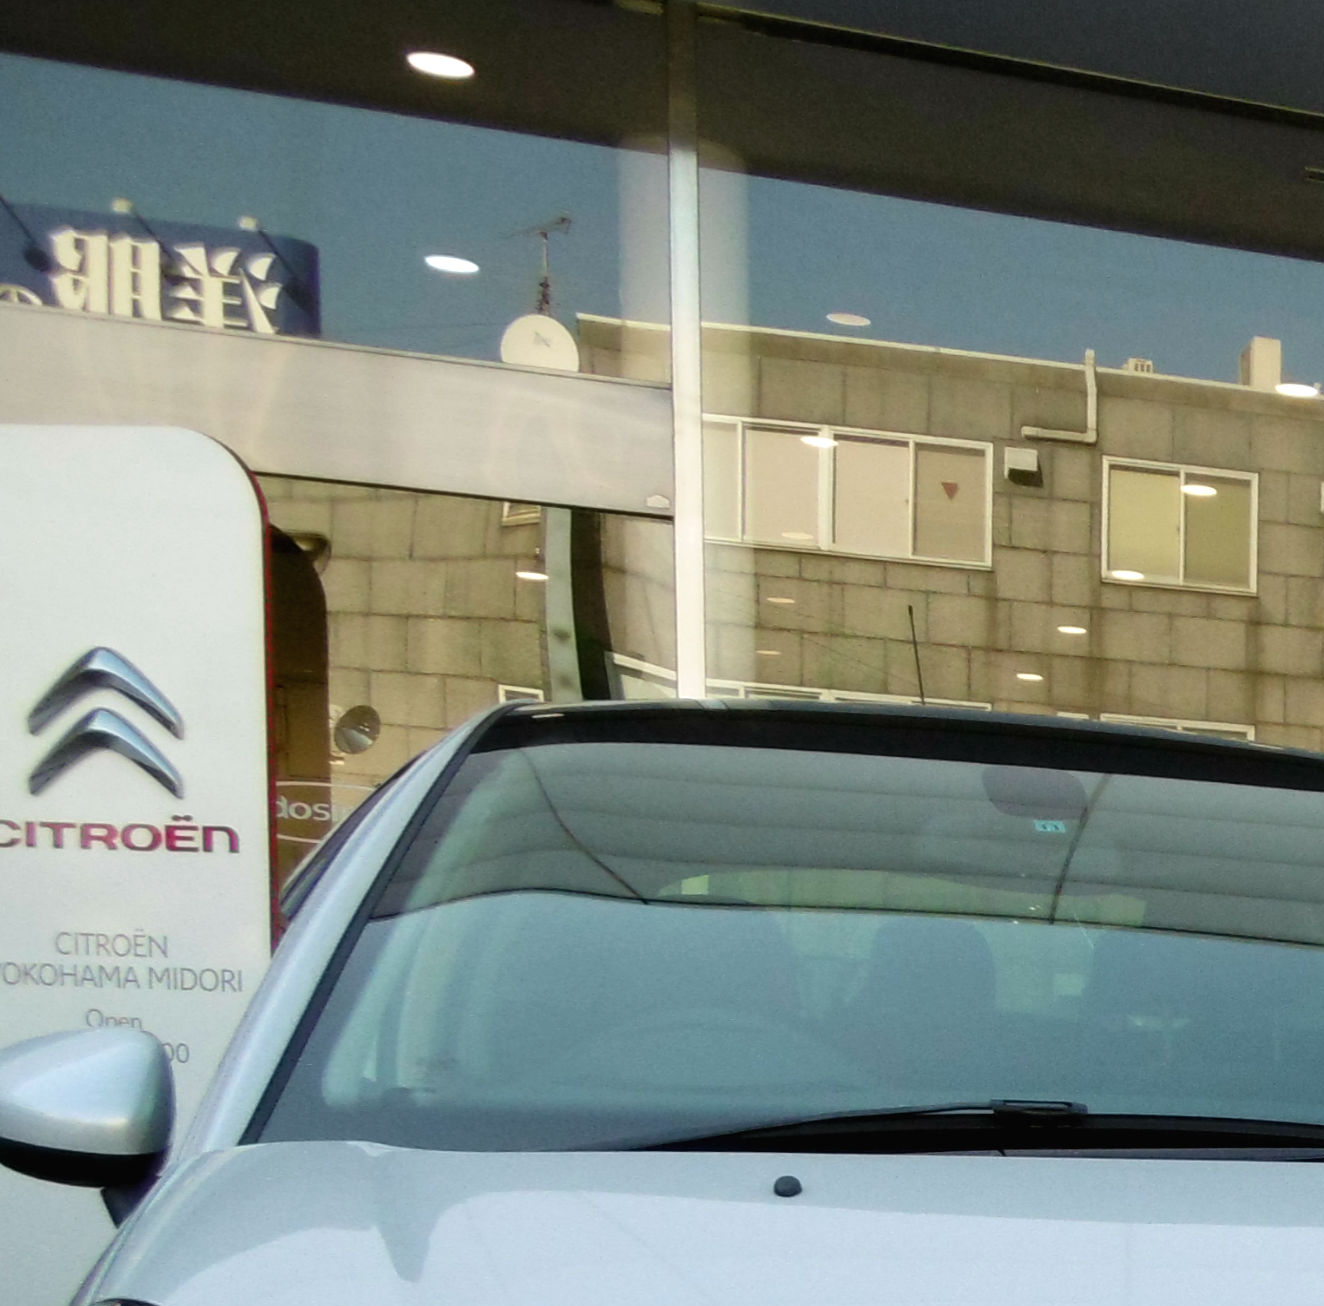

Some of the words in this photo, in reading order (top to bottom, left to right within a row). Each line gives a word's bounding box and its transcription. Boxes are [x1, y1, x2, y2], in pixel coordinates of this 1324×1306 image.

[55, 929, 169, 959] CITROËN
[0, 961, 141, 989] OKOHAMA
[148, 966, 244, 993] MIDORI
